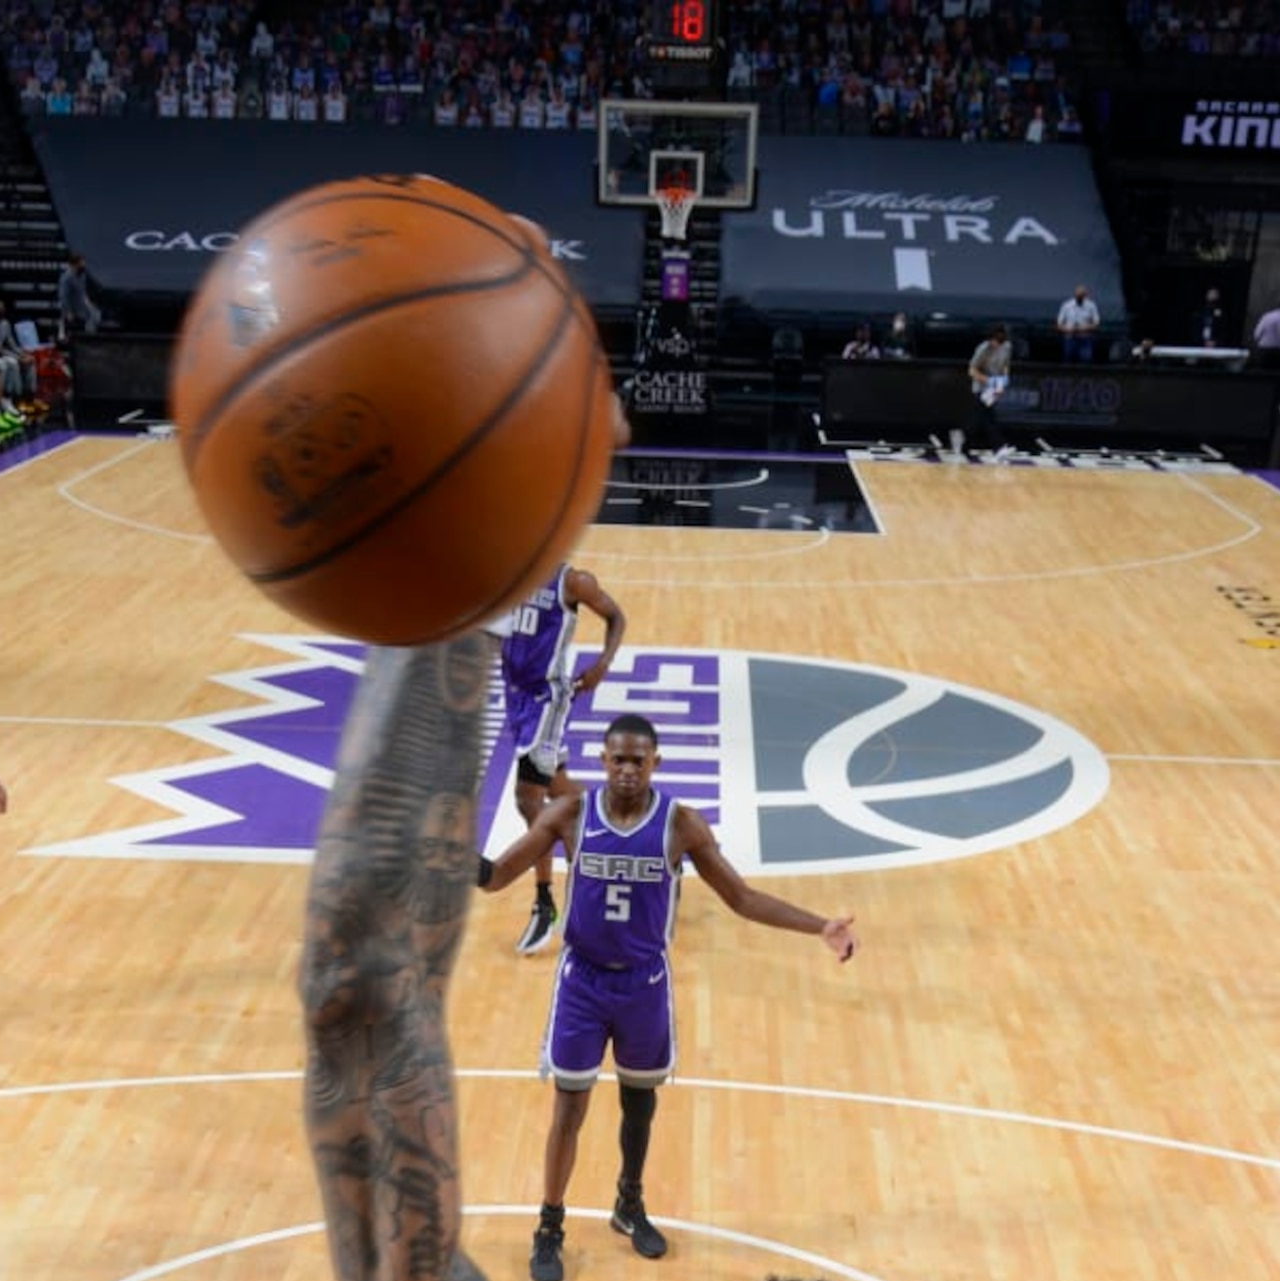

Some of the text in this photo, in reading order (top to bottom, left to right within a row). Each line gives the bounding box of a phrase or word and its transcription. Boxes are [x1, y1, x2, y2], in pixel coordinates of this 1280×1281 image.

[672, 0, 705, 41] 18
[810, 189, 1000, 213] Michelob
[772, 208, 1059, 245] ULTRA
[124, 230, 235, 252] CAC
[634, 371, 707, 389] CACHE
[634, 388, 706, 404] CREEK
[579, 852, 664, 882] SAC
[604, 884, 632, 922] 5
